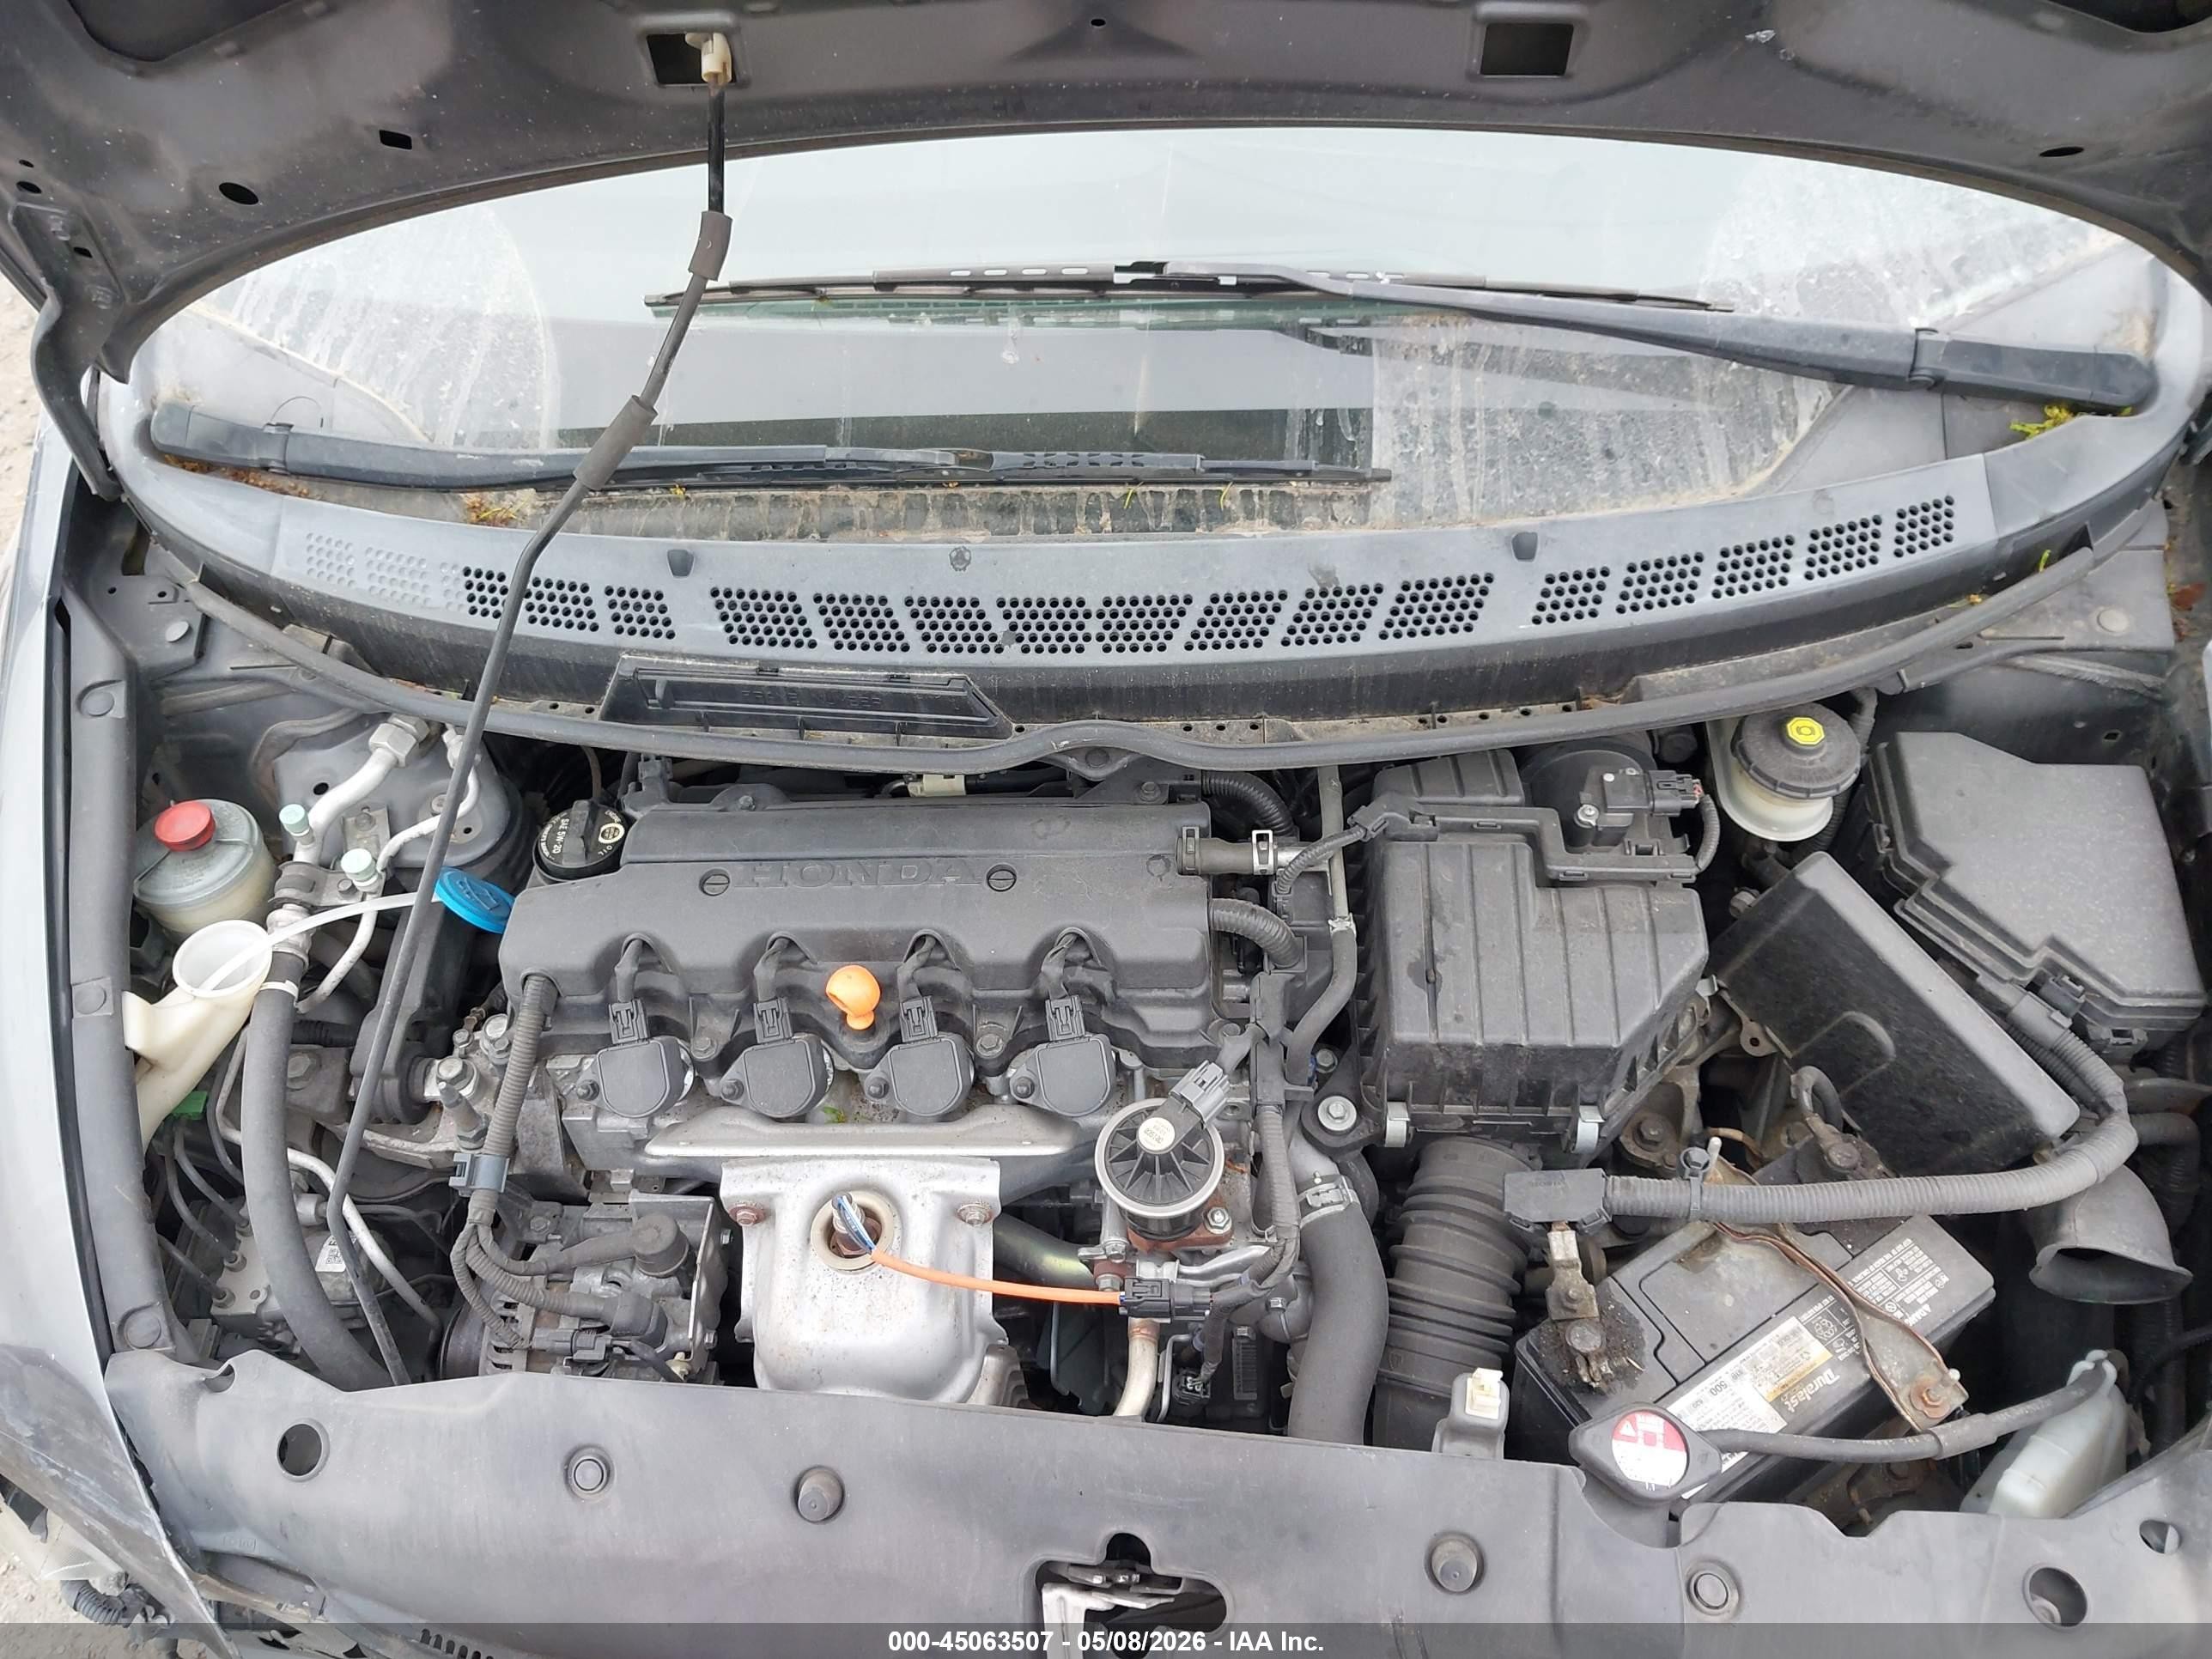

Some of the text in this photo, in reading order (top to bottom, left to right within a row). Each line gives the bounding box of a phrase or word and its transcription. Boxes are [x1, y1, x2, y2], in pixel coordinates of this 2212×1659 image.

[551, 818, 570, 854] SAE 5W-20
[597, 845, 613, 856] OIL
[734, 860, 983, 888] HONDA
[1708, 1379, 1728, 1397] 500
[1783, 1369, 1839, 1413] Duralast
